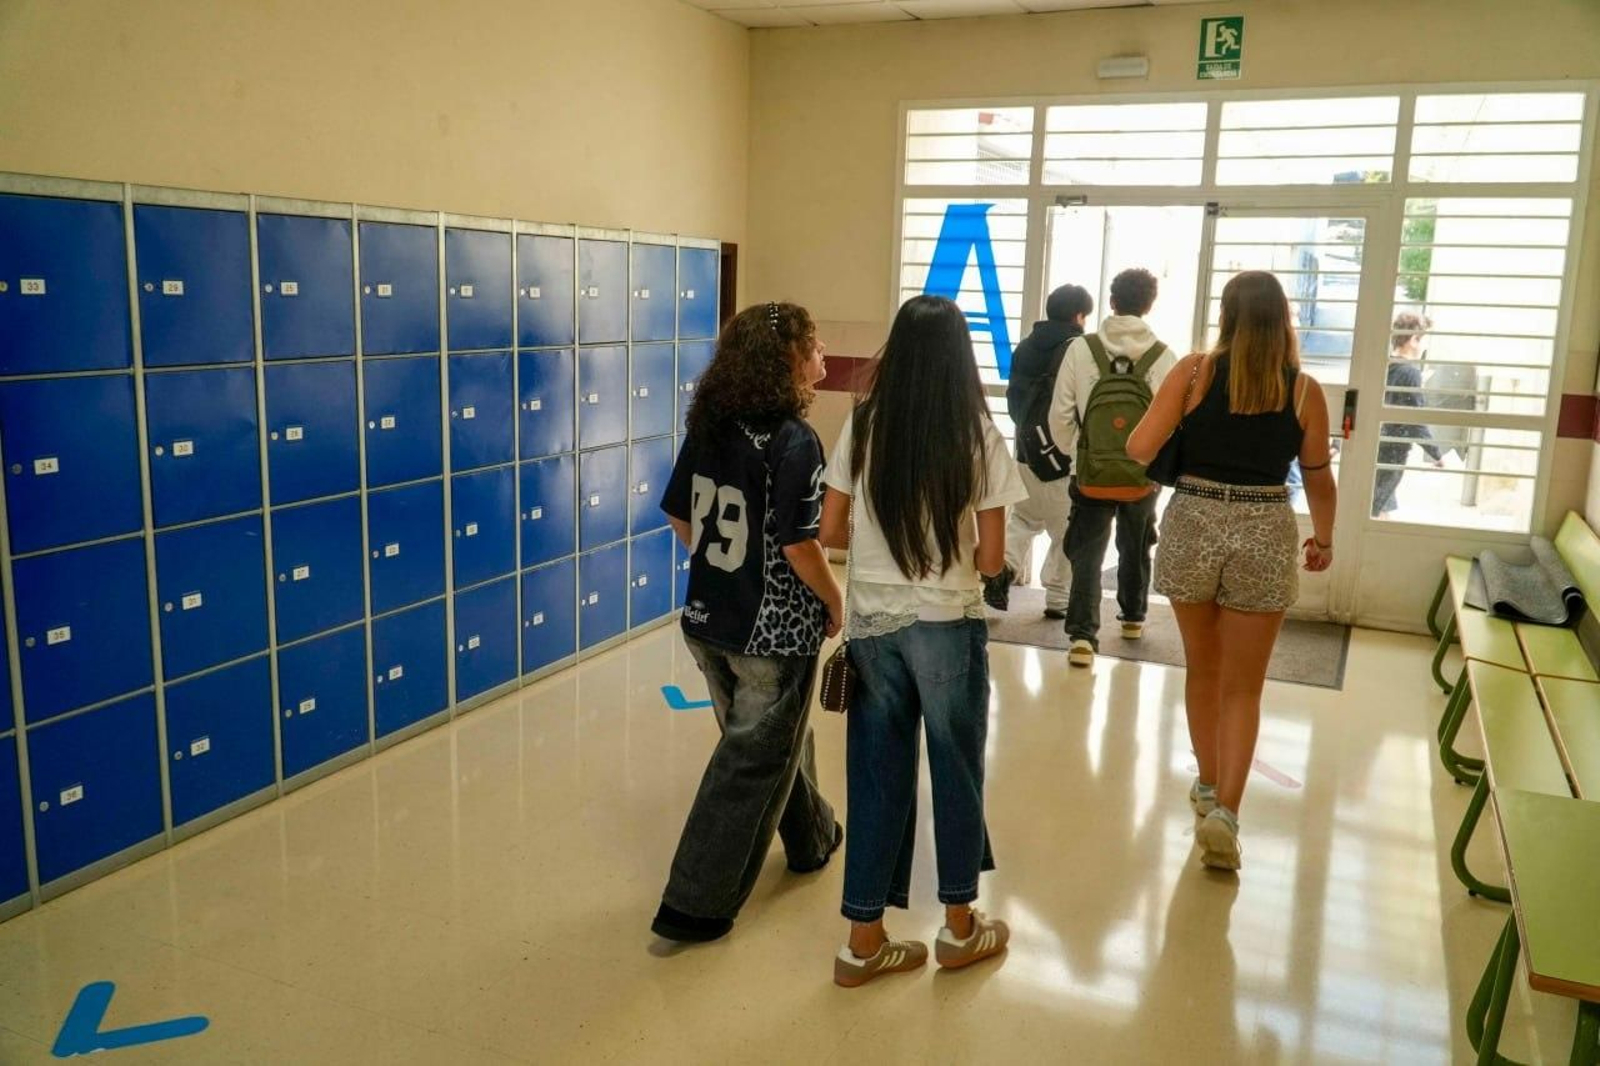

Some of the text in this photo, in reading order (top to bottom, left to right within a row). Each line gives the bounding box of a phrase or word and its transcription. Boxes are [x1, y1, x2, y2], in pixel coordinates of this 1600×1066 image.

[27, 282, 40, 292] 33
[922, 203, 1014, 380] A
[54, 630, 65, 640] 35
